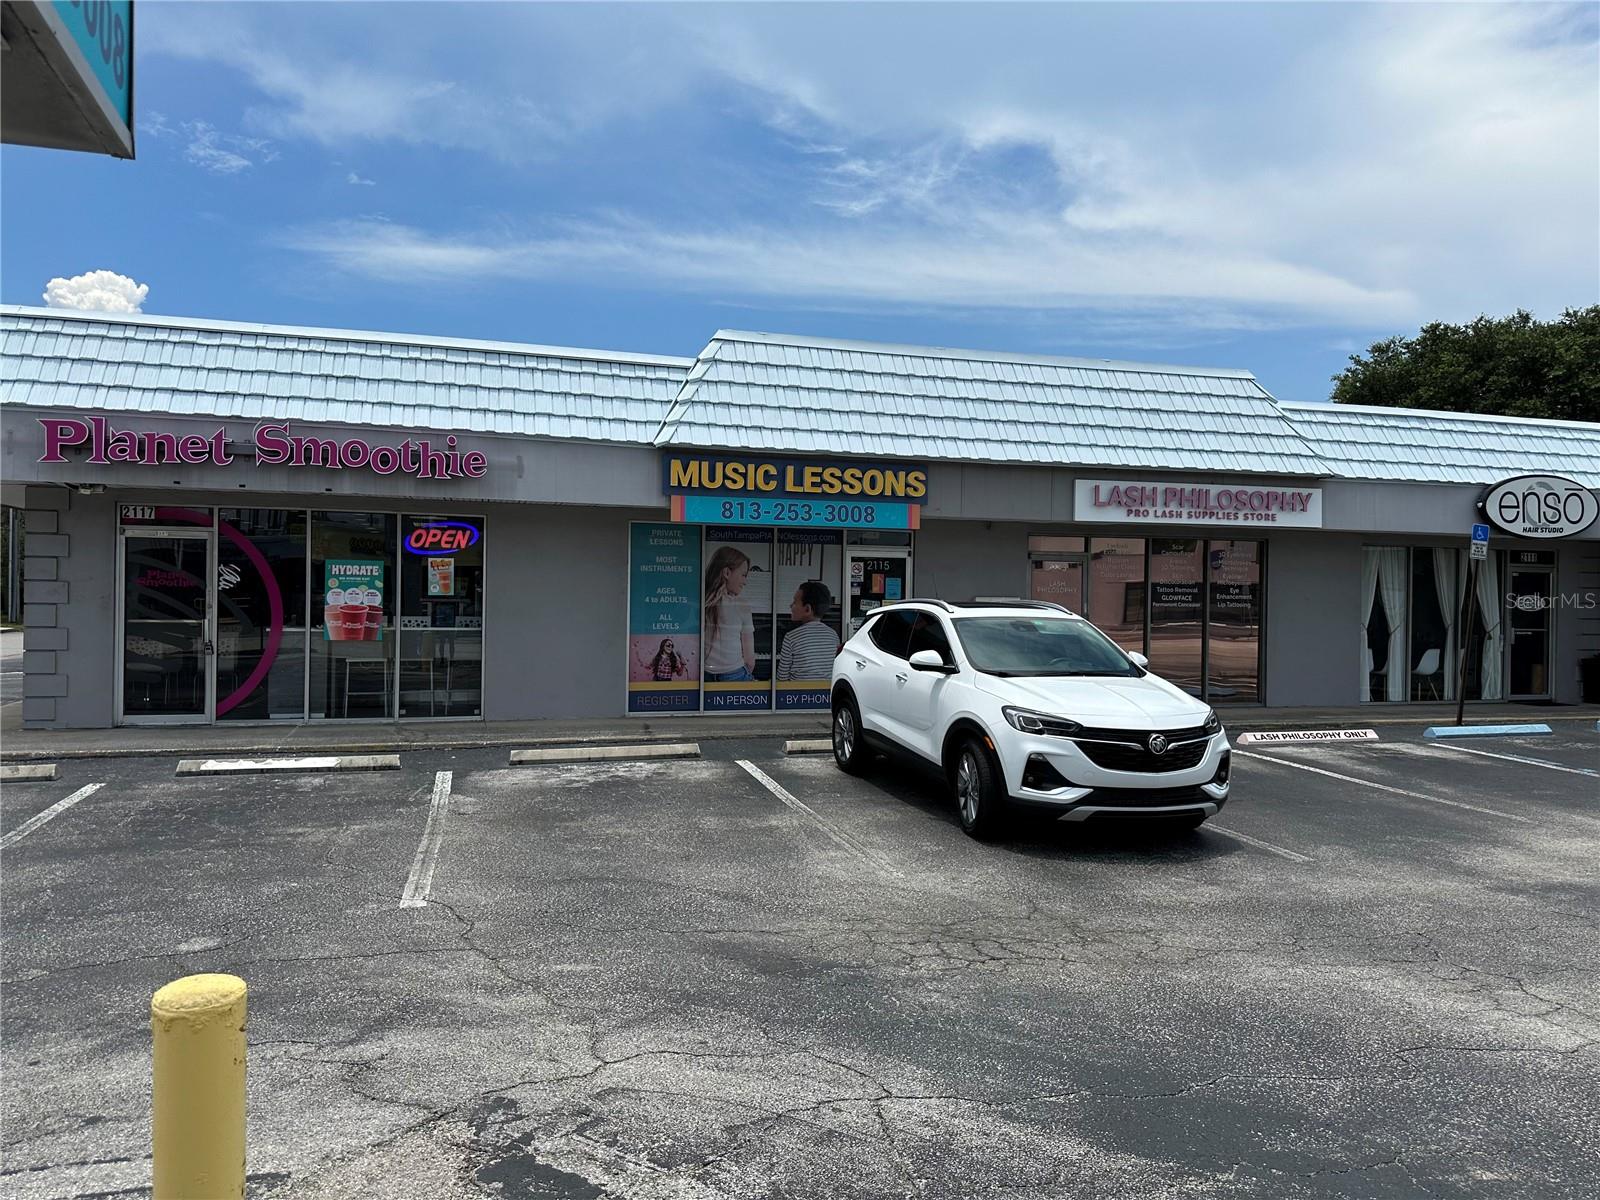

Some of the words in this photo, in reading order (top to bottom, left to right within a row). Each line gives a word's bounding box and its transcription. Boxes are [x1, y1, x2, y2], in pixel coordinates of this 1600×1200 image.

[36, 415, 234, 466] Planet
[254, 420, 488, 480] Smoothie
[670, 459, 778, 491] MUSIC
[785, 465, 927, 498] LESSONS
[1093, 485, 1158, 507] LASH
[1164, 487, 1313, 512] PHILOSOPHY
[122, 506, 155, 518] 2117
[721, 501, 876, 524] 813-253-3008
[1126, 508, 1149, 518] PRO
[1154, 509, 1183, 519] LASH
[1187, 511, 1239, 521] SUPPLIES
[1243, 512, 1277, 522] STORE
[410, 528, 471, 549] OPEN
[651, 529, 683, 537] PRIVATE
[649, 538, 684, 546] LESSONS
[331, 564, 380, 576] HYDRATE
[640, 565, 693, 573] INSTRUMENTS
[867, 561, 890, 570] 2115
[637, 696, 689, 705] REGISTER
[713, 695, 724, 705] IN
[727, 695, 768, 705] PERSON
[786, 694, 798, 704] BY
[1253, 733, 1280, 741] LASH
[1281, 731, 1341, 740] PHILOSOPHY
[1343, 730, 1368, 738] ONLY
